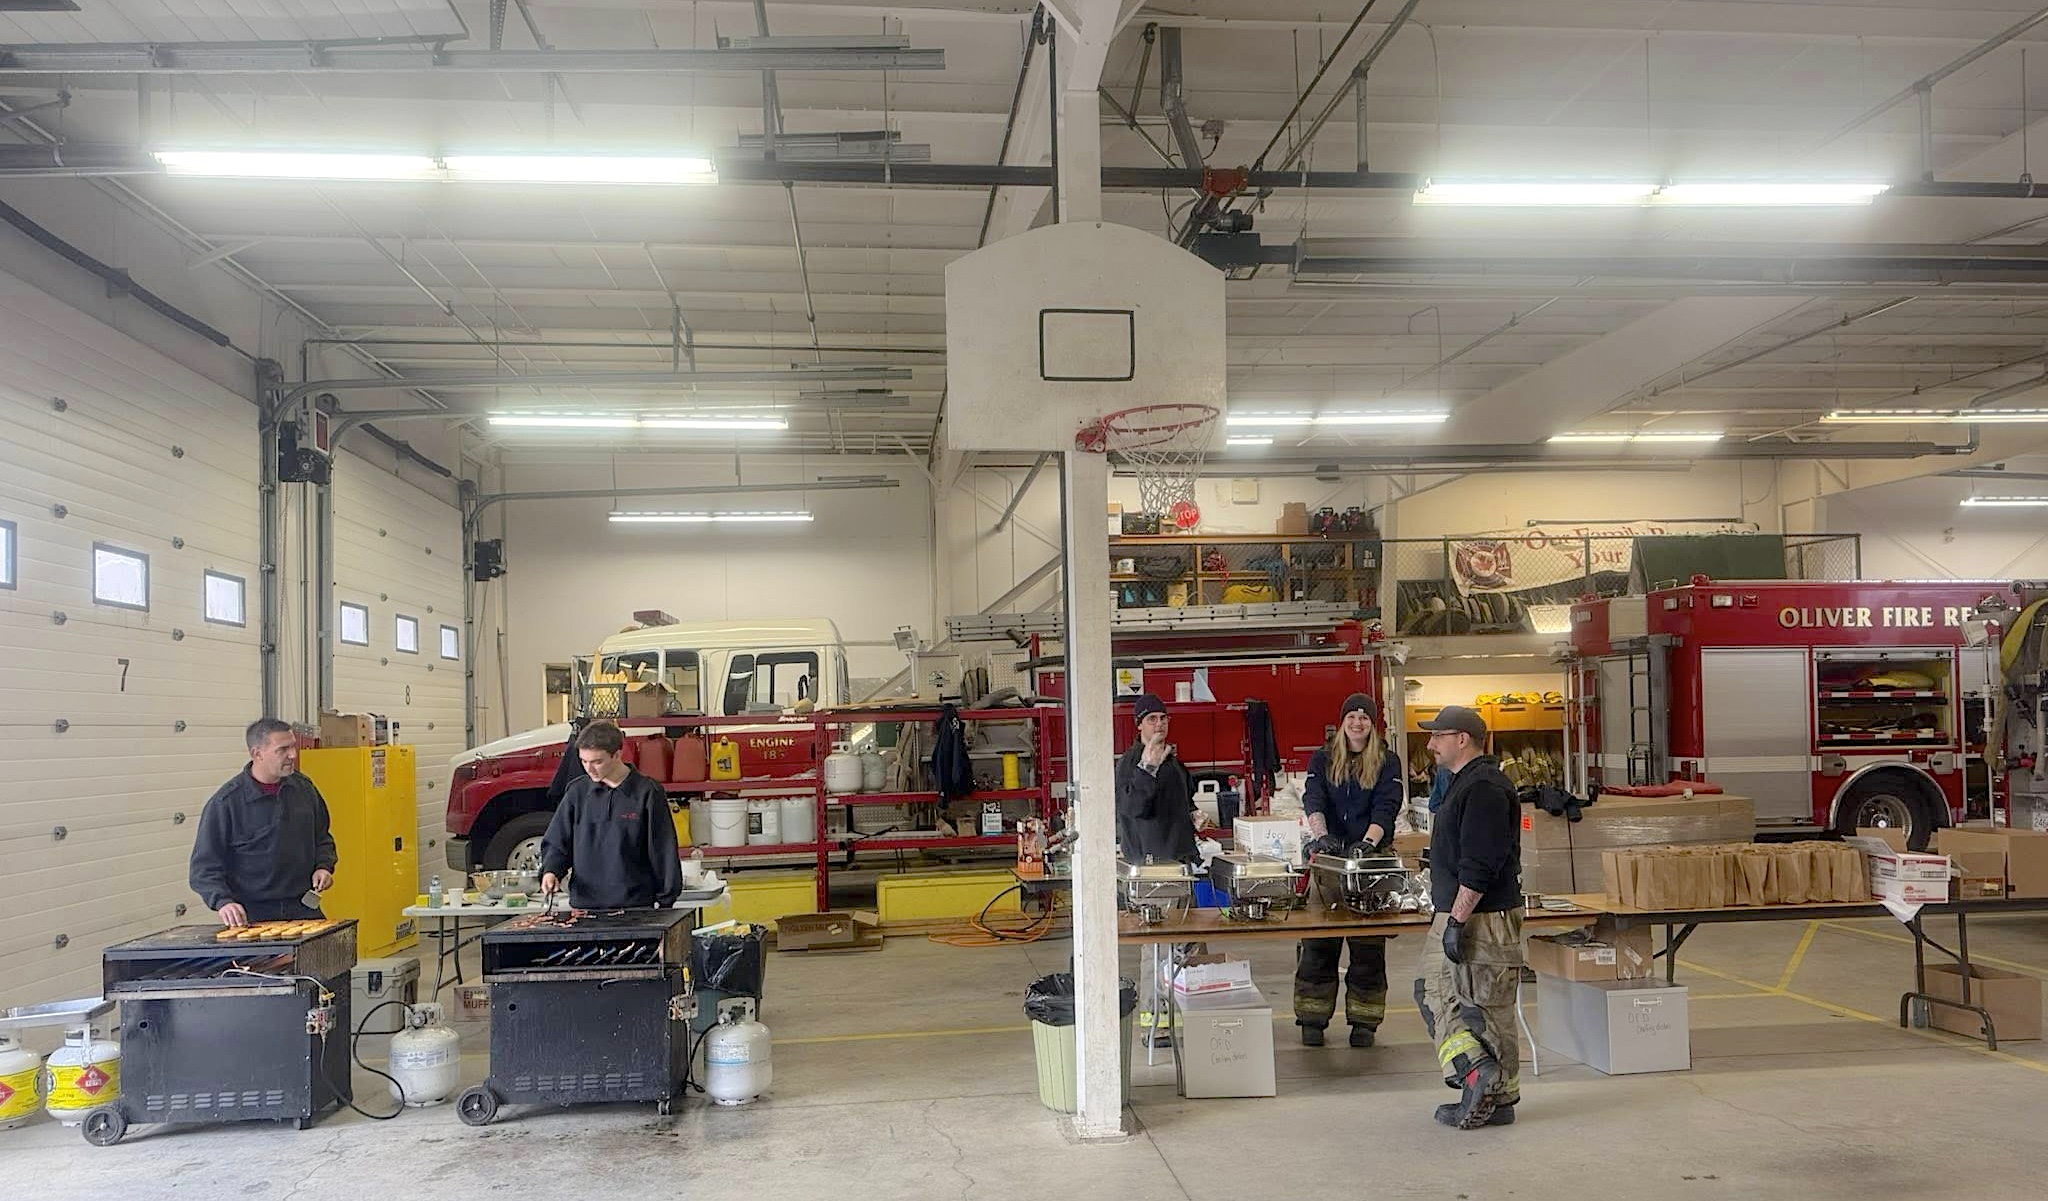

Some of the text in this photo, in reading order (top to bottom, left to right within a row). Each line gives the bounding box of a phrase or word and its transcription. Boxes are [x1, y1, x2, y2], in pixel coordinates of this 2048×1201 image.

[1778, 607, 1873, 628] OLIVER
[1882, 606, 1935, 627] FIRE
[117, 659, 130, 692] 7
[405, 685, 411, 705] 8
[749, 737, 796, 748] ENGINE
